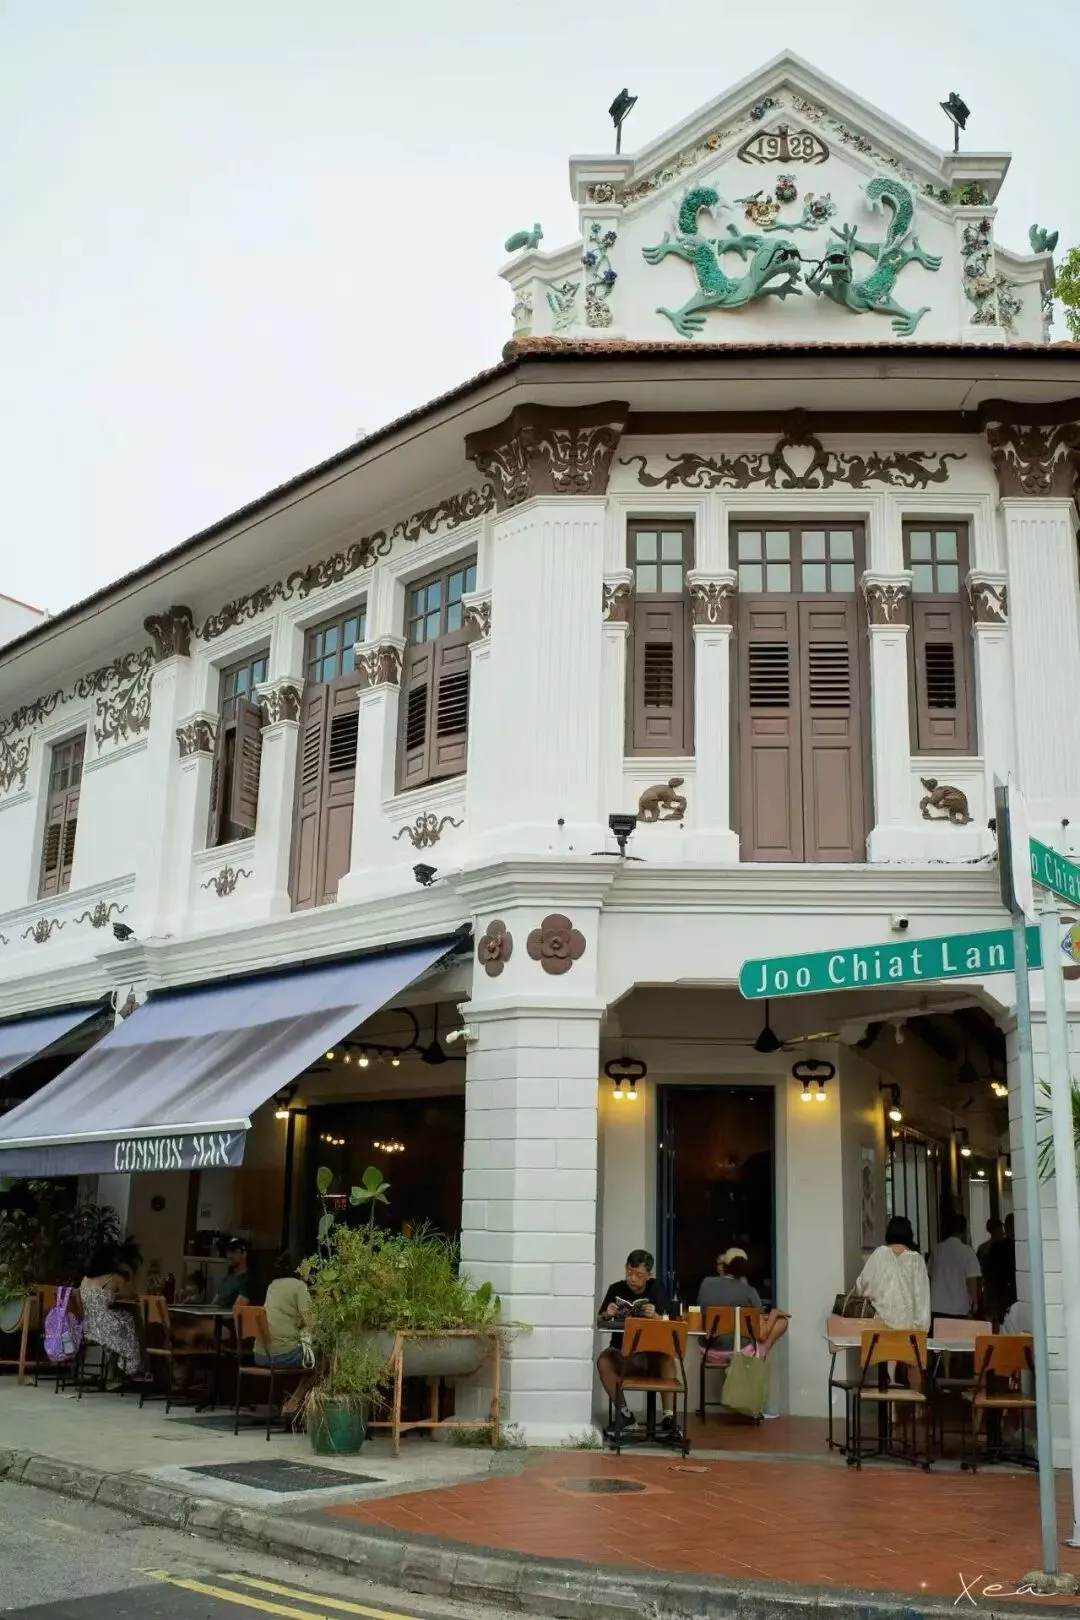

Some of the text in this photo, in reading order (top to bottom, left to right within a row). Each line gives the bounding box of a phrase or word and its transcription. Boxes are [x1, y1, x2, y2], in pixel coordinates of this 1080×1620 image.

[756, 942, 1029, 993] Joo Chiat Lan
[114, 1133, 231, 1171] COMMON MAN
